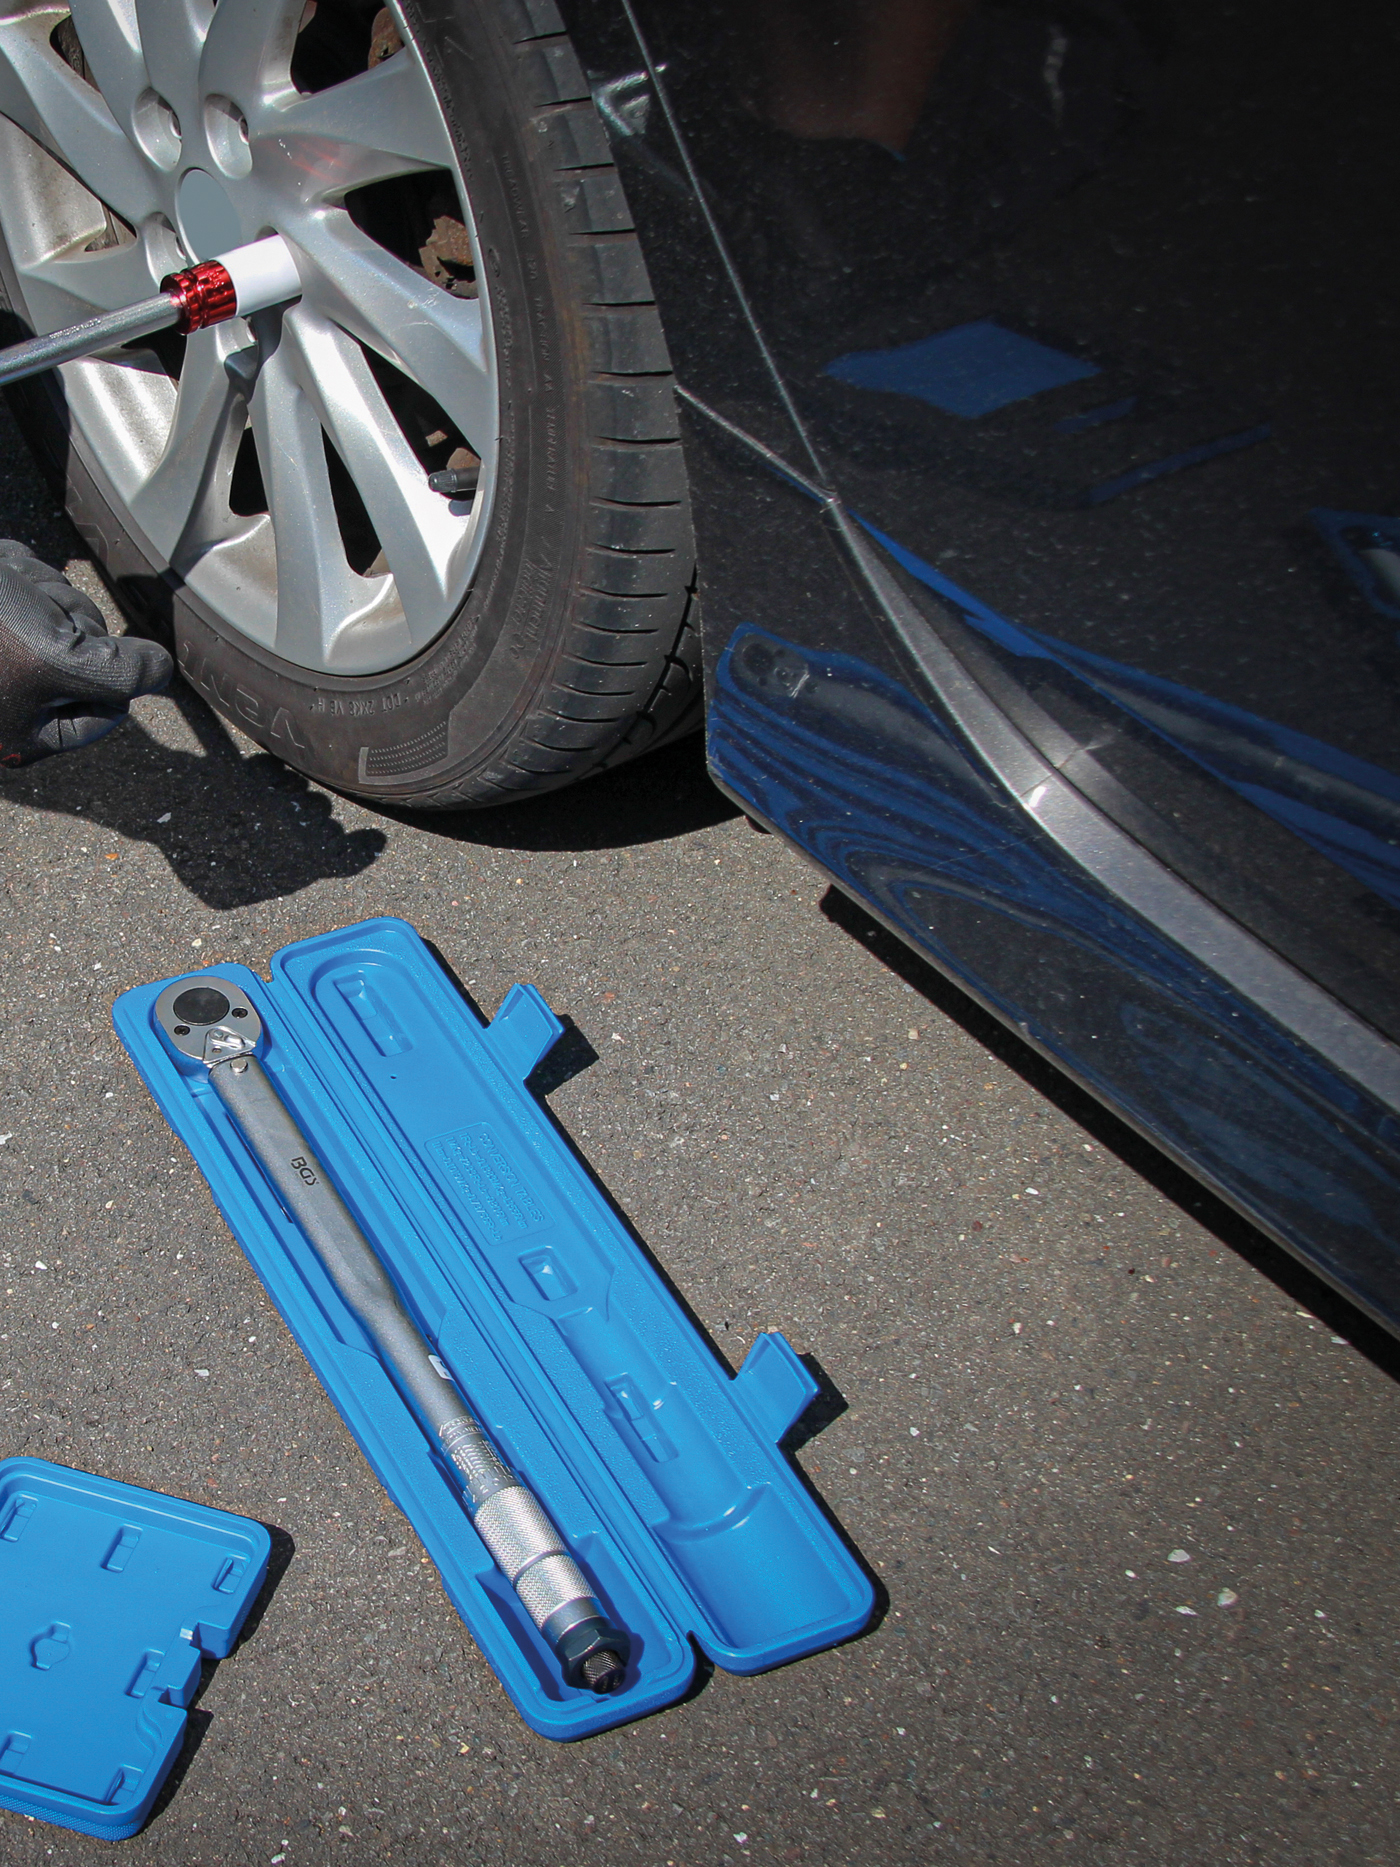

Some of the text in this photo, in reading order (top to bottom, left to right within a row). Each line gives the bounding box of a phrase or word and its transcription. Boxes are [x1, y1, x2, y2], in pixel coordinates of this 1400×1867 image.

[381, 692, 401, 713] DOT
[290, 1156, 318, 1186] BGS
[478, 1131, 545, 1222] CONVERSION TABLES
